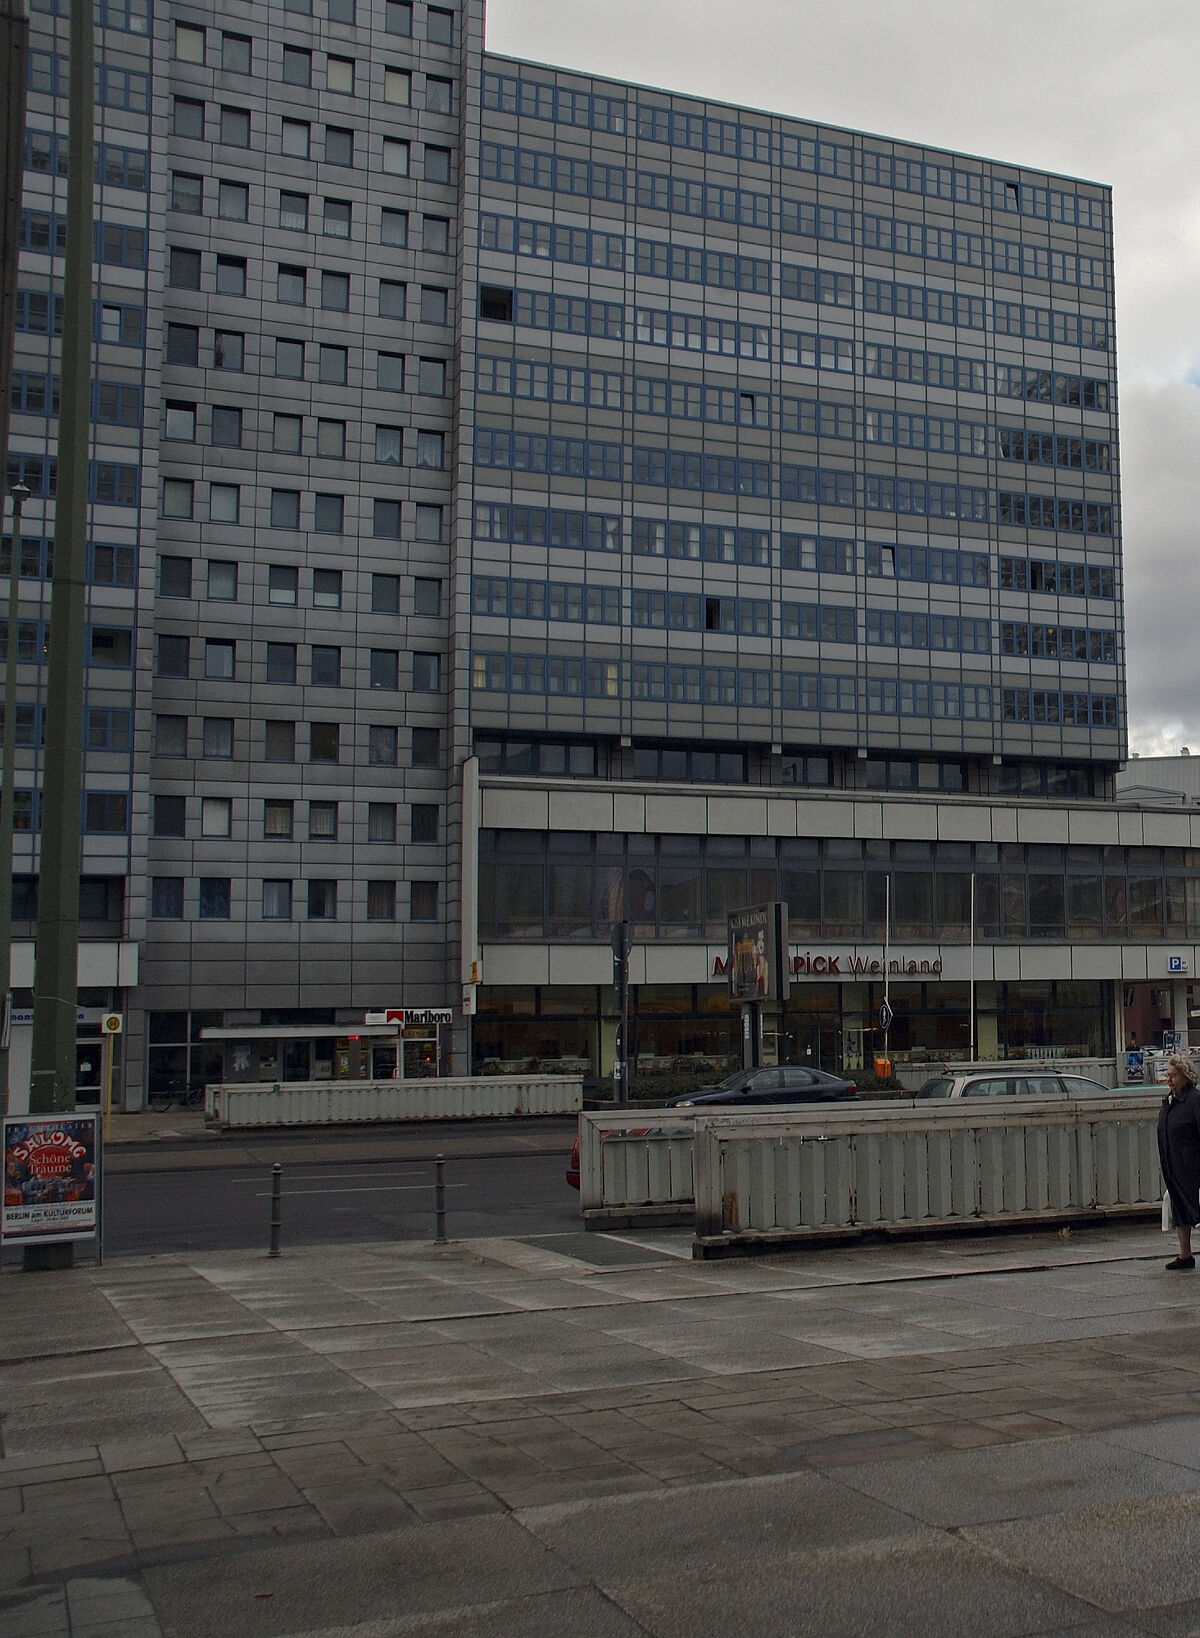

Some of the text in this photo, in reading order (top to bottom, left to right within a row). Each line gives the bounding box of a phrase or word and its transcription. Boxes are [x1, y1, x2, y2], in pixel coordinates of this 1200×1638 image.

[404, 1010, 451, 1023] Marlboro
[30, 1152, 71, 1164] Schöne
[29, 1163, 72, 1175] Träume
[6, 1212, 30, 1220] BERLIN
[43, 1207, 93, 1217] KULTURFORUM
